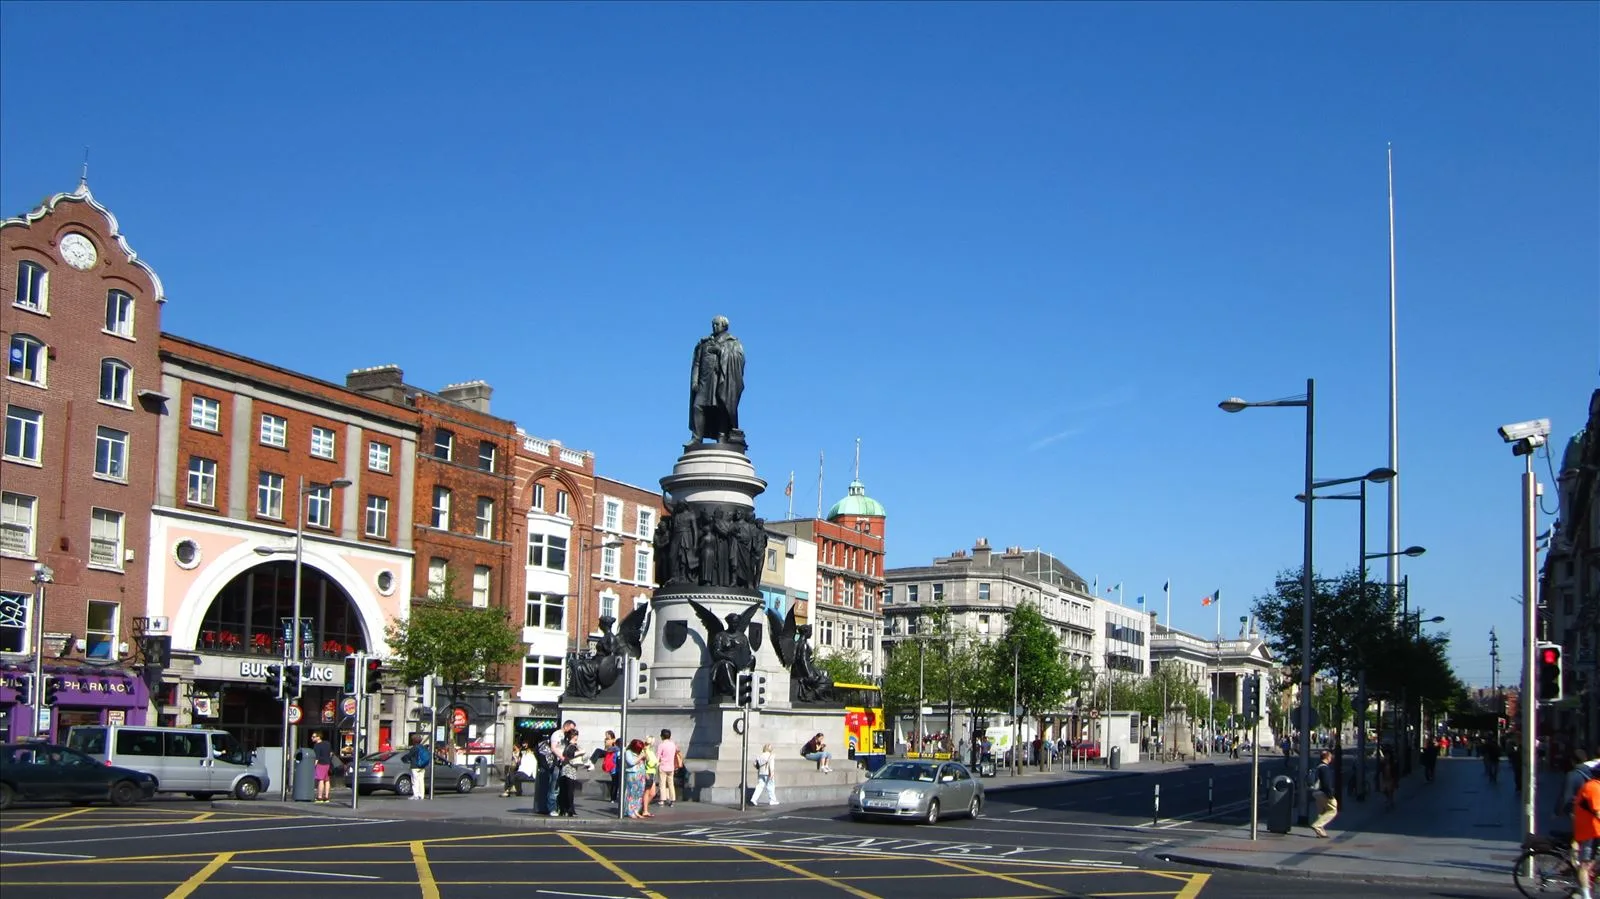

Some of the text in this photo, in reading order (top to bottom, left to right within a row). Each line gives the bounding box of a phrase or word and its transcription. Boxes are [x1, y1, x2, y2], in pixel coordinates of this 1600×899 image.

[302, 665, 334, 681] ING
[64, 681, 133, 692] PHARMACY
[779, 834, 1051, 855] ENTRY
